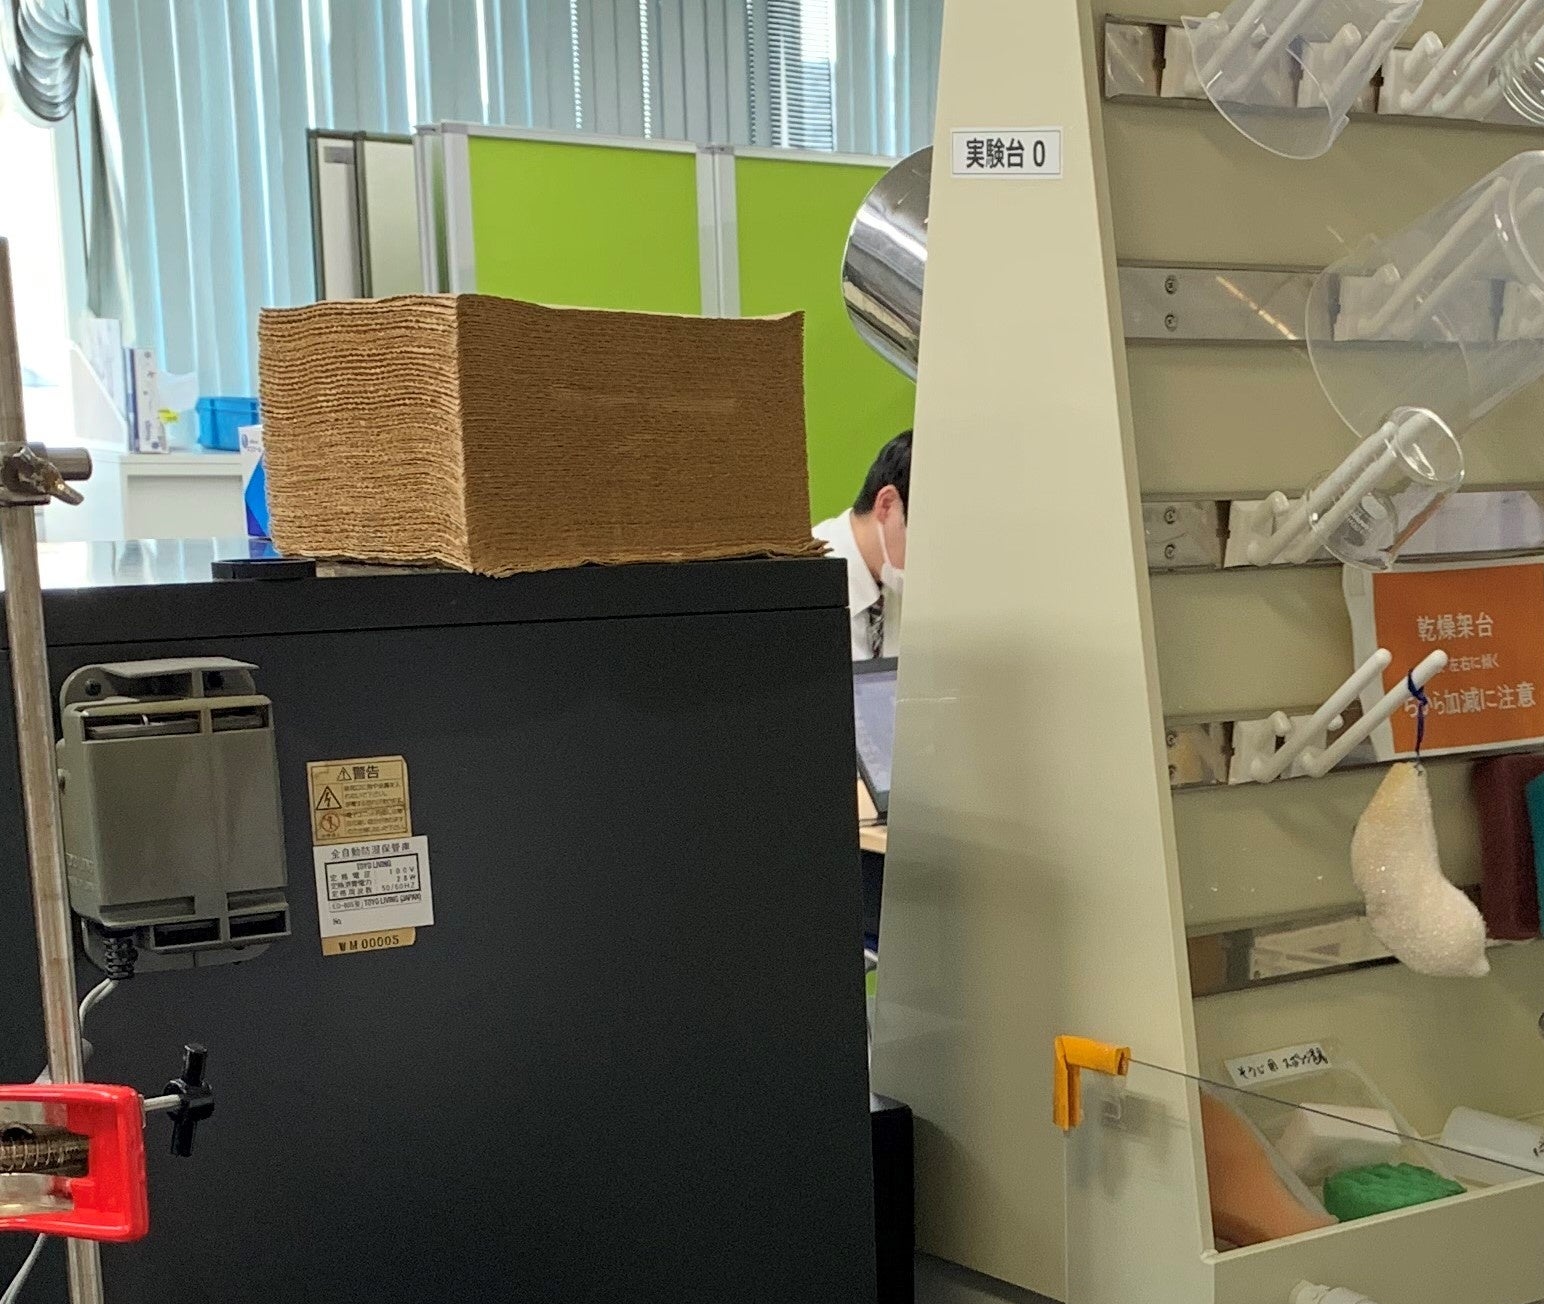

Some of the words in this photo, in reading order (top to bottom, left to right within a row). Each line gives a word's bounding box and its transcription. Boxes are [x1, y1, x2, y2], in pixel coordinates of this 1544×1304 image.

[966, 137, 1025, 168] 実験台
[1033, 139, 1046, 167] 0
[1416, 612, 1494, 642] 乾燥架台
[352, 765, 380, 780] 警告
